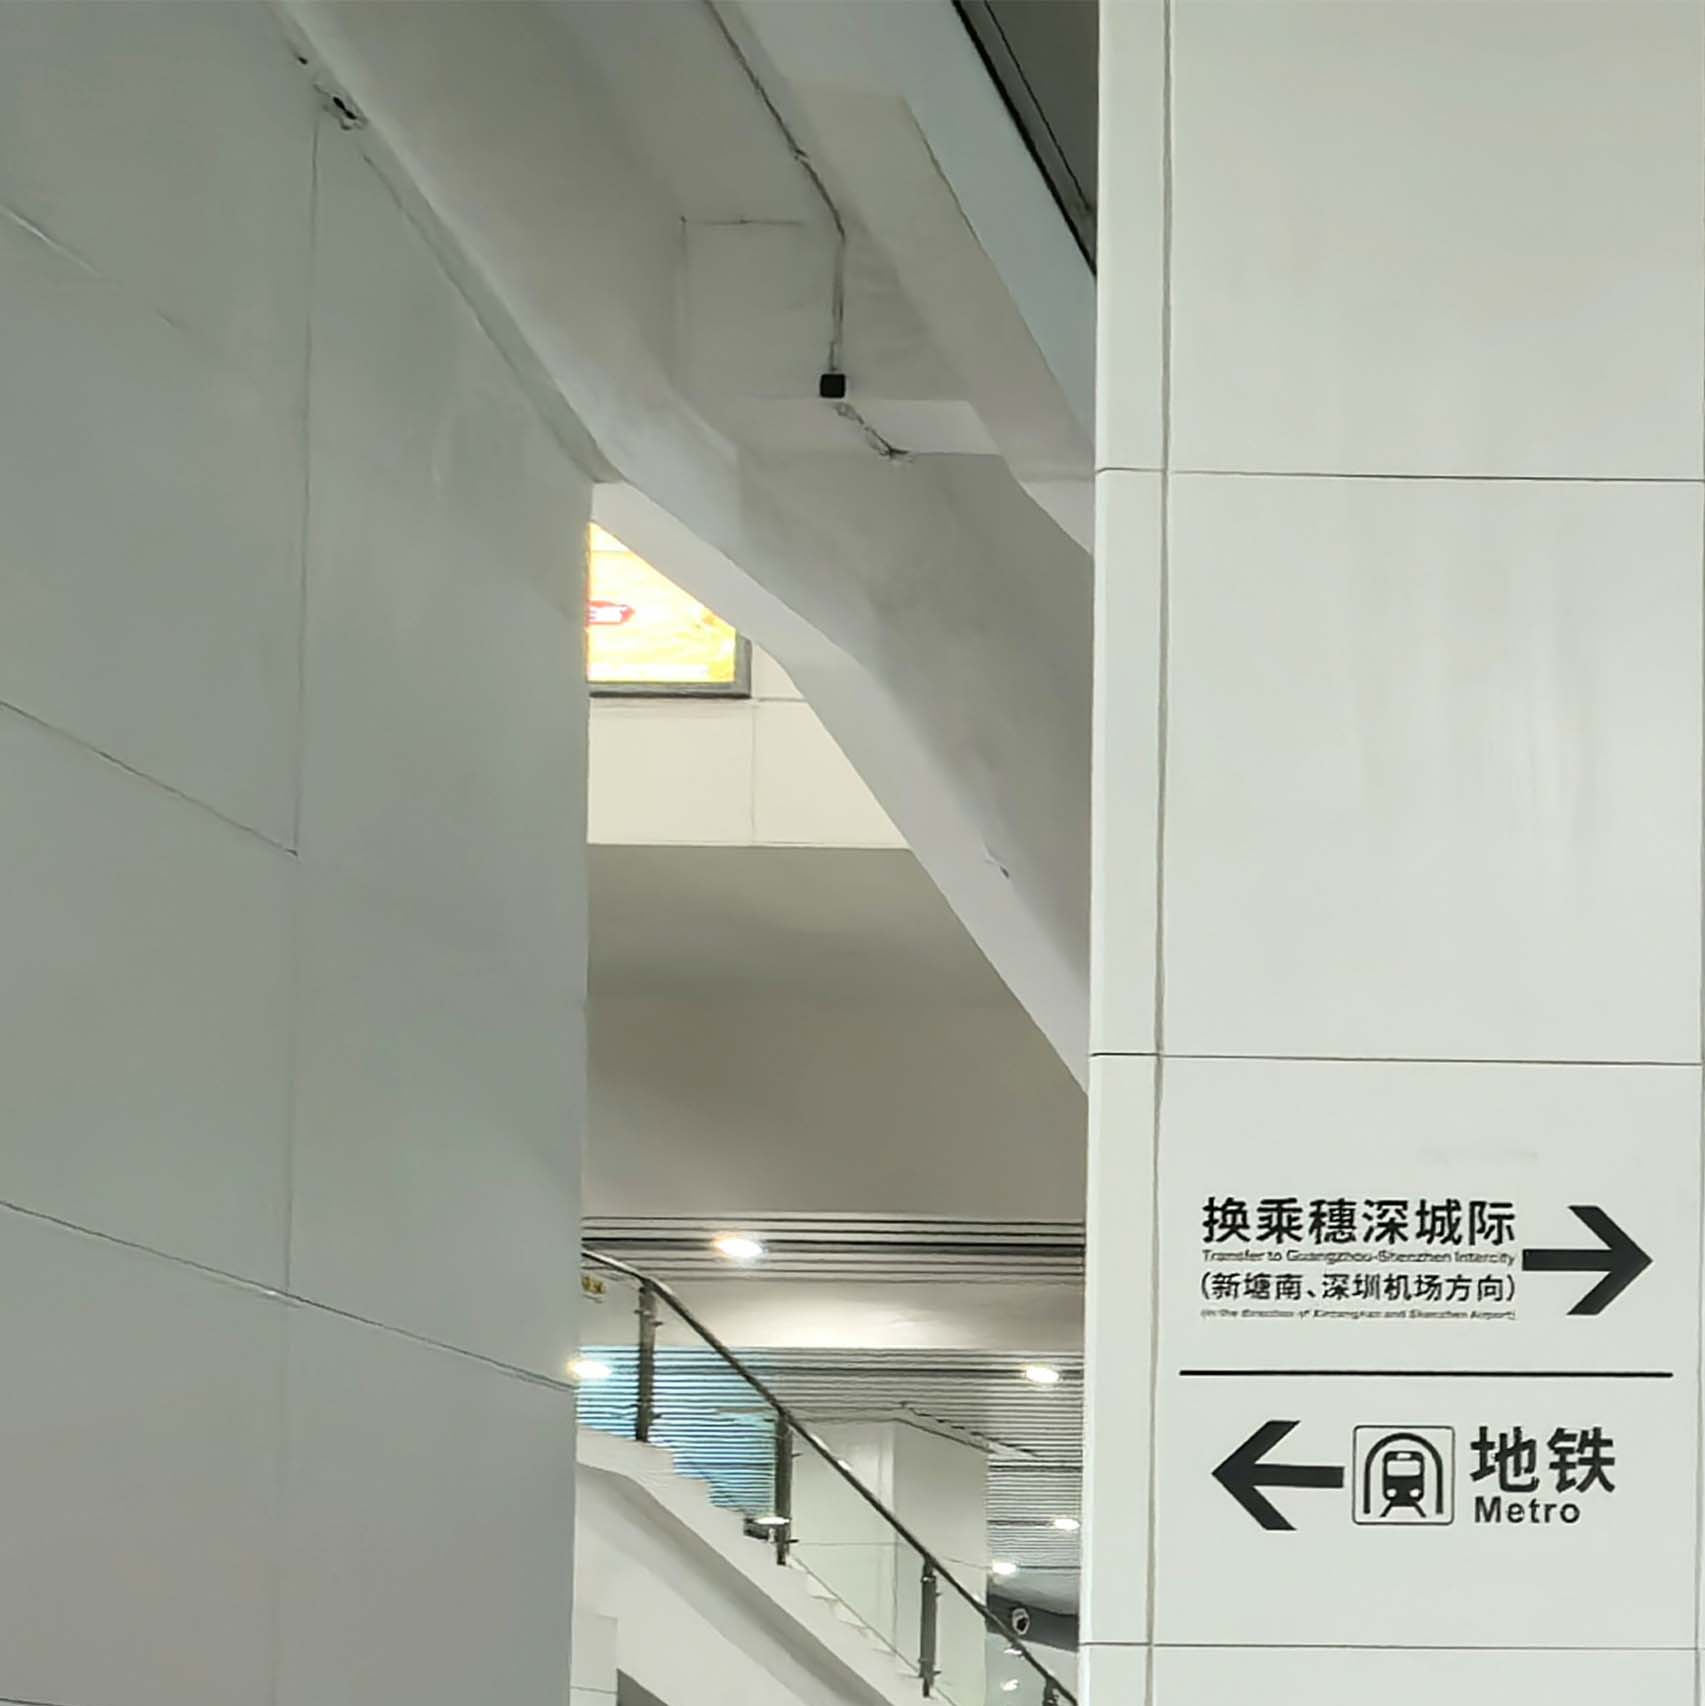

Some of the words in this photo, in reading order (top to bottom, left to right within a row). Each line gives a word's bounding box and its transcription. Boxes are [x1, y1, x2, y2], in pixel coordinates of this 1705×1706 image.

[1202, 1196, 1516, 1246] 换乘穗深城际
[1202, 1249, 1264, 1262] Transfer
[1267, 1250, 1283, 1262] to
[1454, 1251, 1516, 1267] Intercity
[1469, 1426, 1616, 1494] 地铁
[1475, 1496, 1581, 1525] Metro
